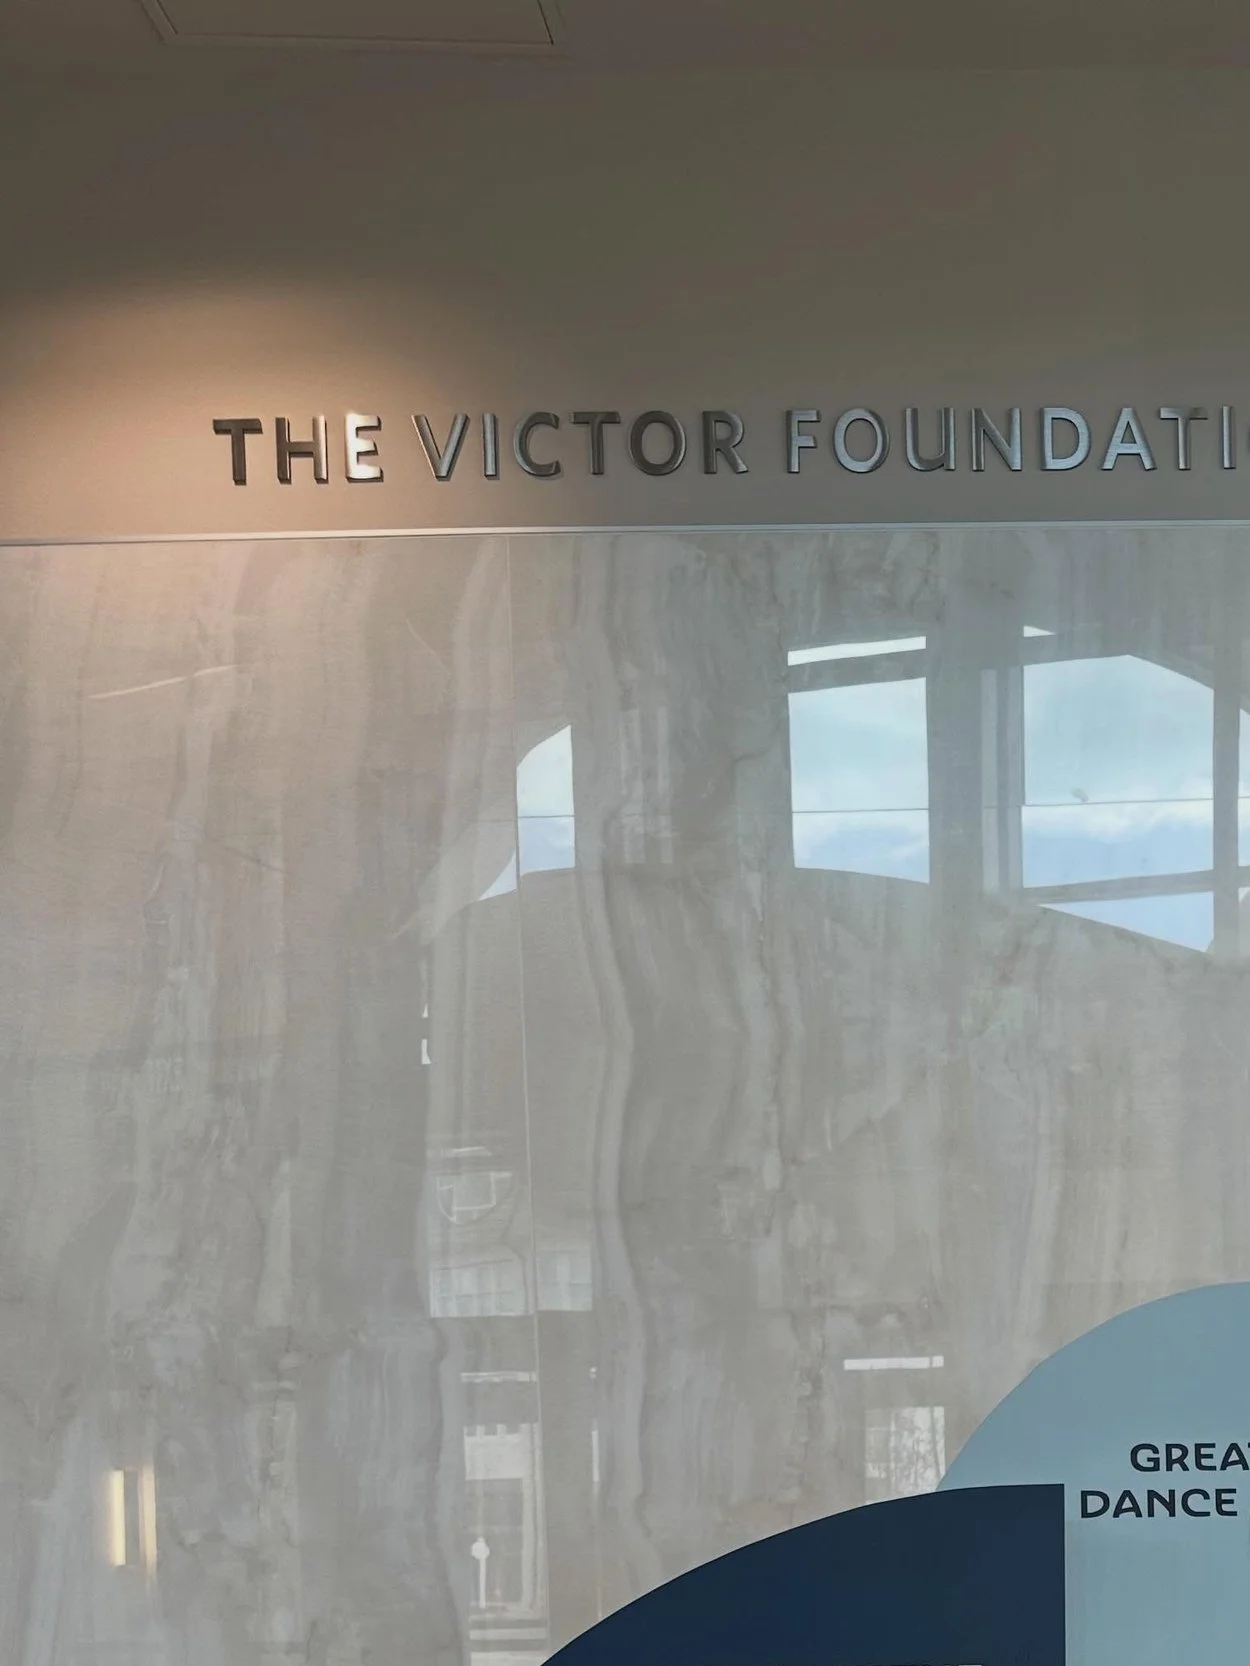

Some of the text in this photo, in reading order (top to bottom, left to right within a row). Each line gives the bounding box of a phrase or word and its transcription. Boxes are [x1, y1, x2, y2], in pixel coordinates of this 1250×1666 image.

[213, 412, 384, 485] THE
[411, 409, 748, 480] VICTOR
[1080, 1487, 1239, 1519] DANCE
